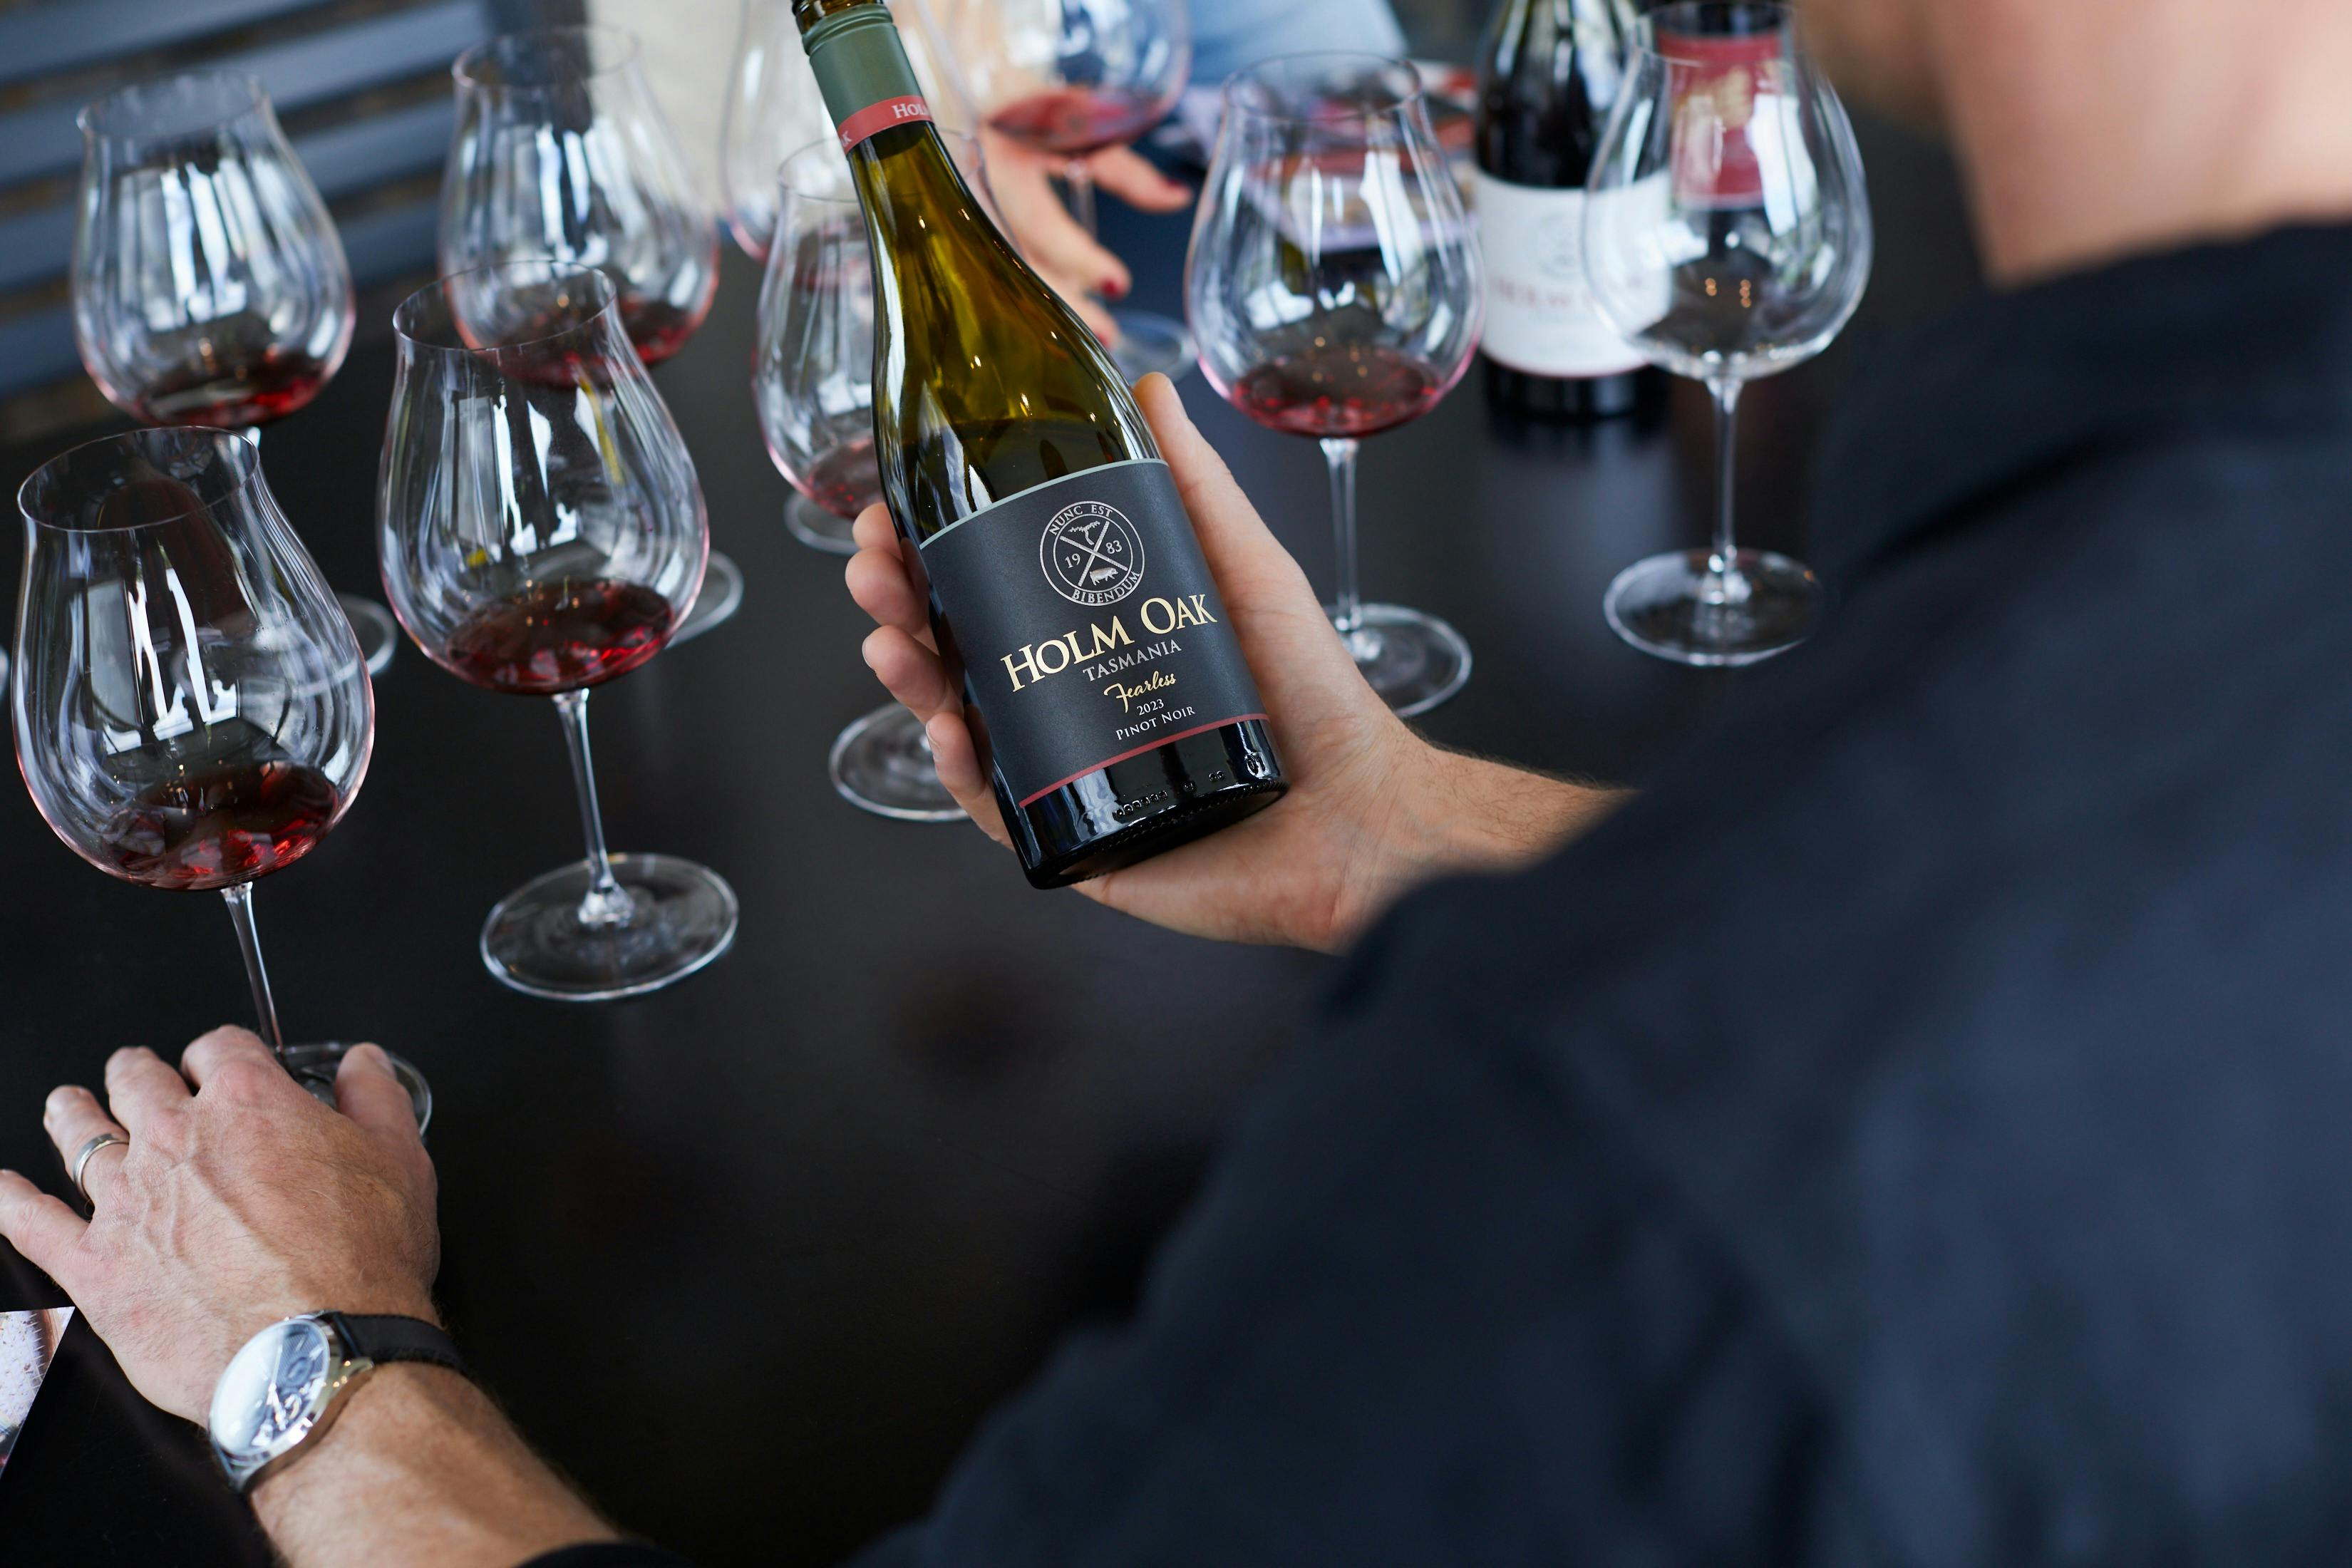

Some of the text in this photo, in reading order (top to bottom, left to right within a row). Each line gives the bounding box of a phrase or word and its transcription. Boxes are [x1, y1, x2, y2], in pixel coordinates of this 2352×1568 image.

[891, 103, 929, 118] HOL
[1049, 504, 1113, 535] NUNC EST
[1065, 540, 1123, 569] 19 83
[1071, 571, 1140, 604] BIBENDUM
[1000, 594, 1217, 693] HOLM OAK
[1082, 639, 1182, 681] TASMANIA
[1103, 671, 1177, 713] Fearless
[1136, 698, 1165, 716] 2023
[1115, 706, 1196, 741] PINOT NOIR
